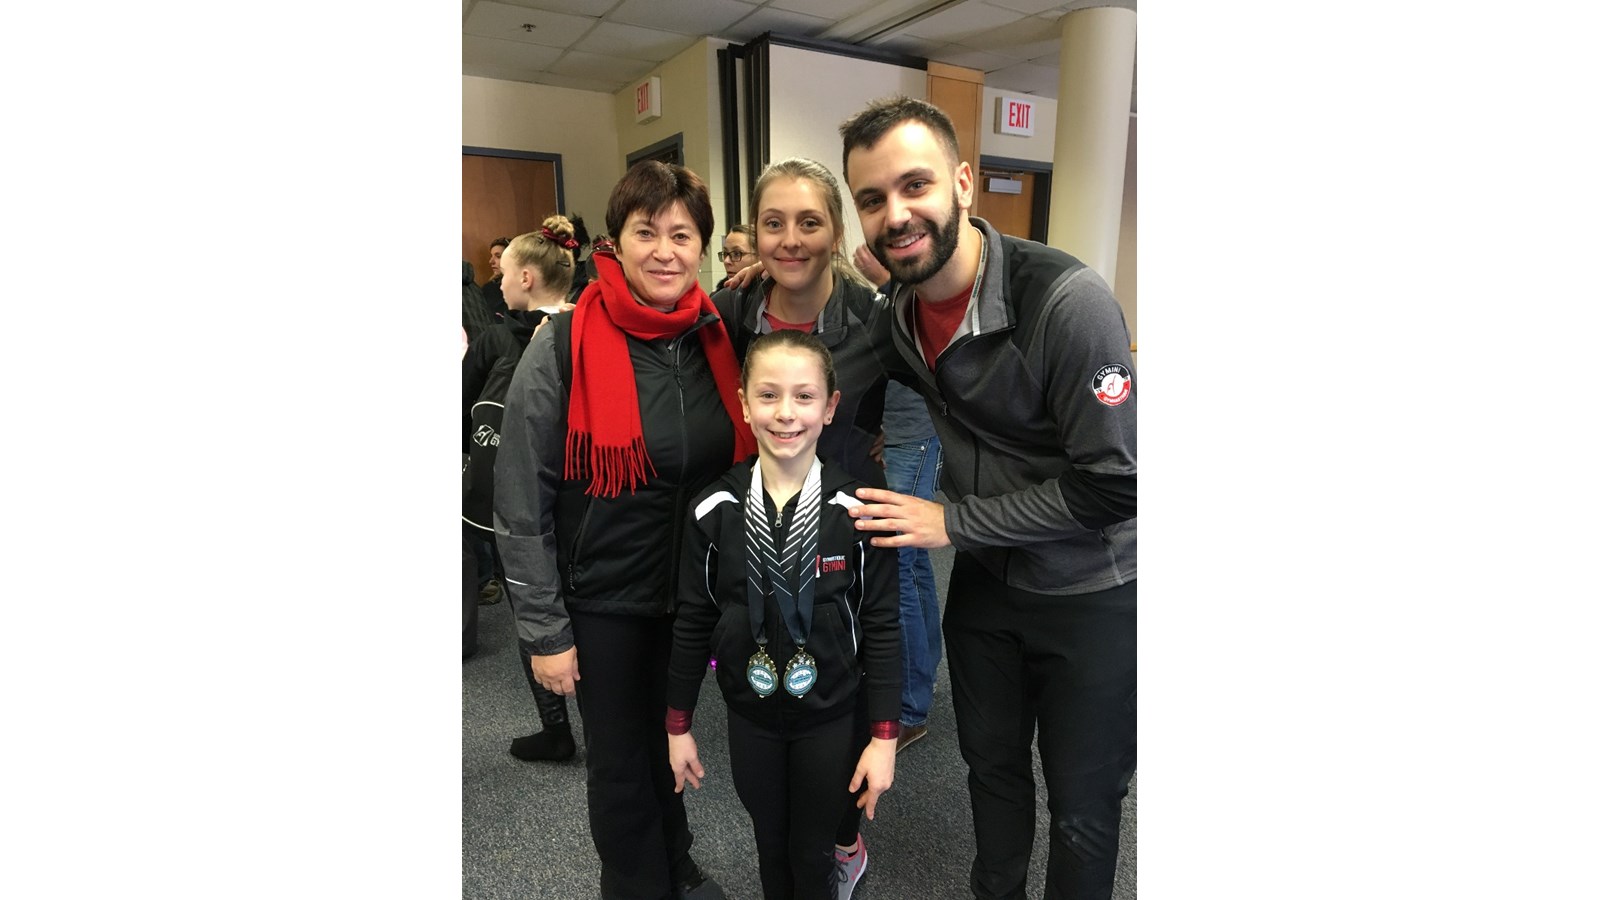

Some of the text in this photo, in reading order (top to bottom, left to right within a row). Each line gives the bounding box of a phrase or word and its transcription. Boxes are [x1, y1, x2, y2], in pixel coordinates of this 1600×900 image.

[636, 82, 649, 114] EXIT
[1008, 101, 1031, 129] EXIT
[1097, 366, 1121, 380] GYMINI
[822, 560, 846, 573] GYMINI
